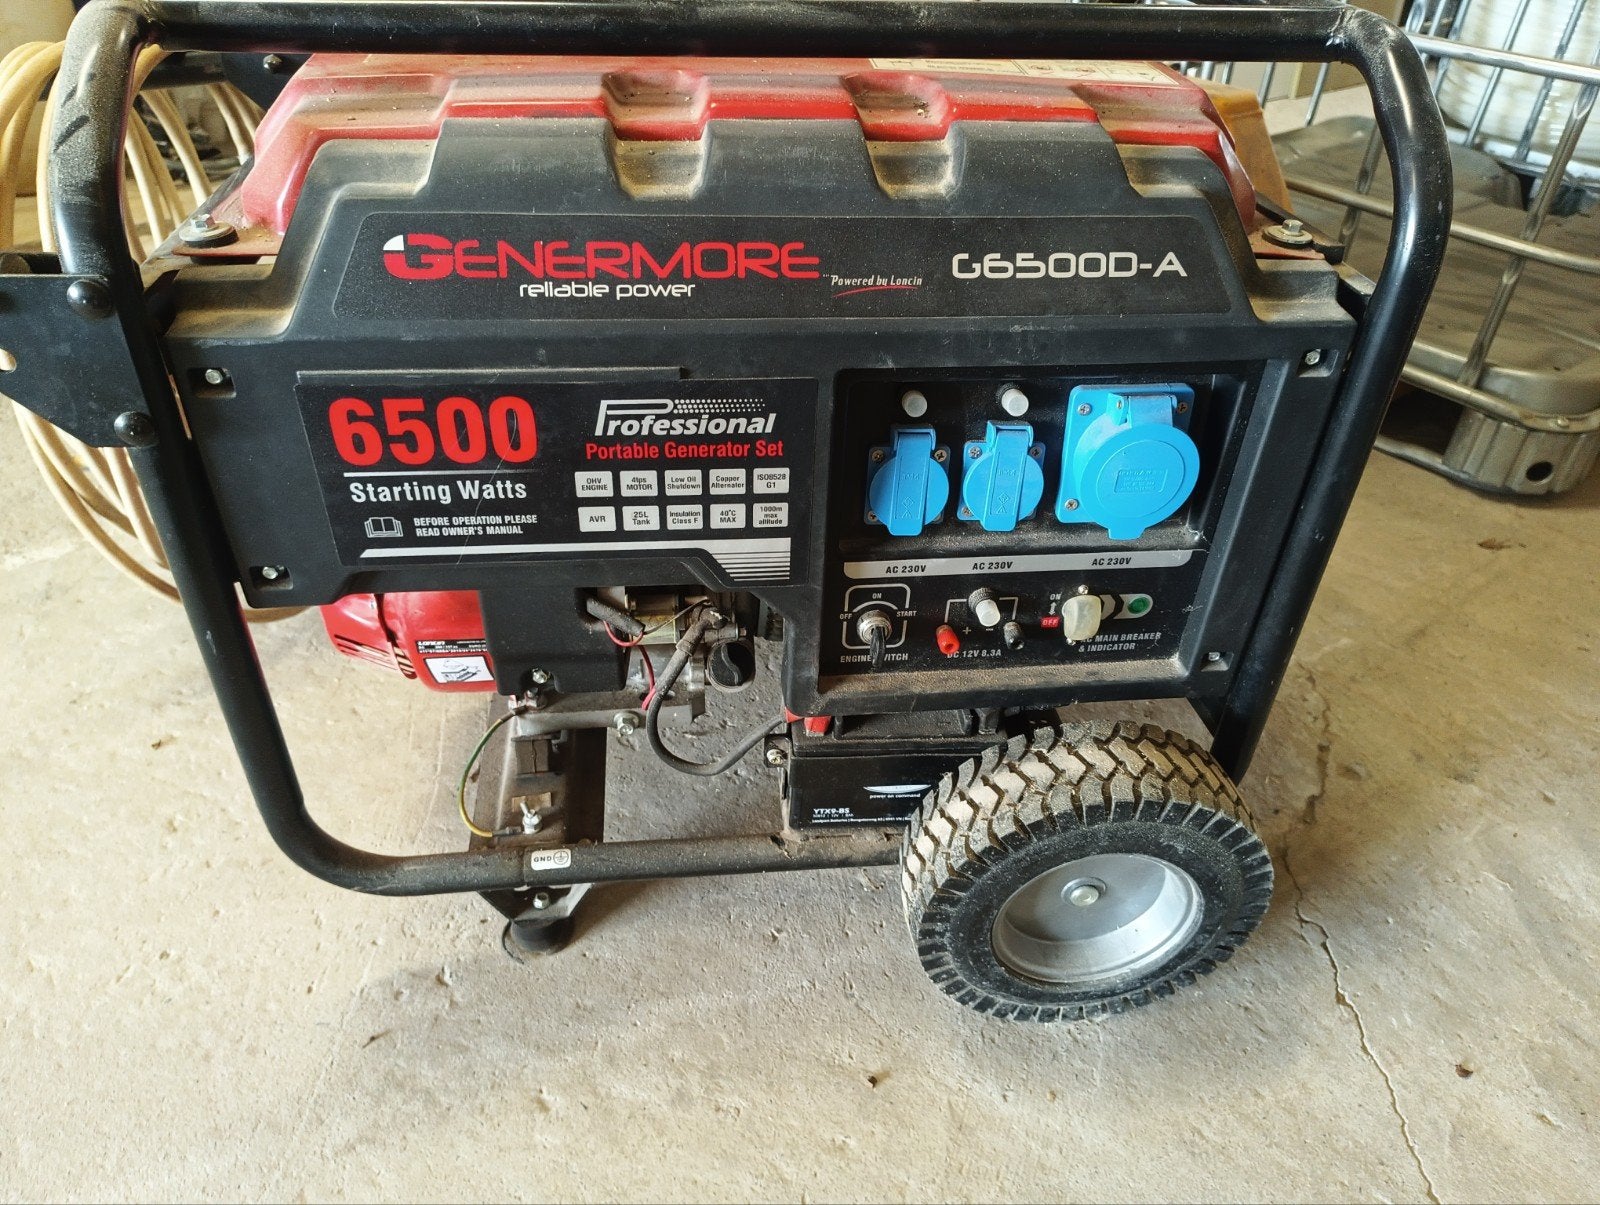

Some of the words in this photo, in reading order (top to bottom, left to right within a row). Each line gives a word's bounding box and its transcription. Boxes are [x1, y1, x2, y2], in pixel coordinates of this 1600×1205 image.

[383, 233, 820, 280] GENERMORE
[952, 251, 1188, 279] G6500D-A
[830, 274, 874, 286] Powered
[877, 274, 888, 287] by
[890, 274, 923, 286] Loncin
[519, 281, 610, 298] reliable
[616, 284, 696, 301] power
[594, 398, 777, 436] Professional
[328, 395, 538, 466] 6500
[585, 442, 660, 460] Portable
[664, 441, 751, 458] Generator
[755, 439, 784, 457] Set
[586, 477, 602, 485] OHV
[766, 481, 776, 489] G1
[349, 481, 451, 504] Starting
[456, 480, 527, 500] Watts
[626, 483, 653, 491] MOTOR
[589, 515, 606, 523] AVR
[669, 510, 701, 518] Insulation
[413, 517, 450, 527] BEFORE
[452, 515, 503, 526] OPERATION
[504, 514, 538, 525] PLEASE
[632, 518, 651, 526] Tank
[672, 517, 692, 525] Class
[416, 527, 441, 537] READ
[442, 526, 484, 537] OWNER'S
[486, 525, 524, 535] MANUAL
[972, 562, 985, 571] AC
[988, 561, 1013, 570] 230V
[1092, 557, 1105, 566] AC
[1107, 556, 1132, 566] 230V
[885, 566, 899, 574] AC
[901, 564, 927, 573] 230V
[872, 592, 882, 600] ON
[1050, 593, 1062, 601] ON
[896, 610, 917, 618] START
[1041, 618, 1059, 626] OFF
[1095, 634, 1118, 643] MAIN
[1120, 632, 1162, 641] BREAKER
[1078, 645, 1085, 653] &
[1087, 642, 1136, 652] INDICATOR
[840, 654, 871, 663] ENGINE
[962, 649, 979, 658] 12V
[981, 649, 1001, 657] 8.3A
